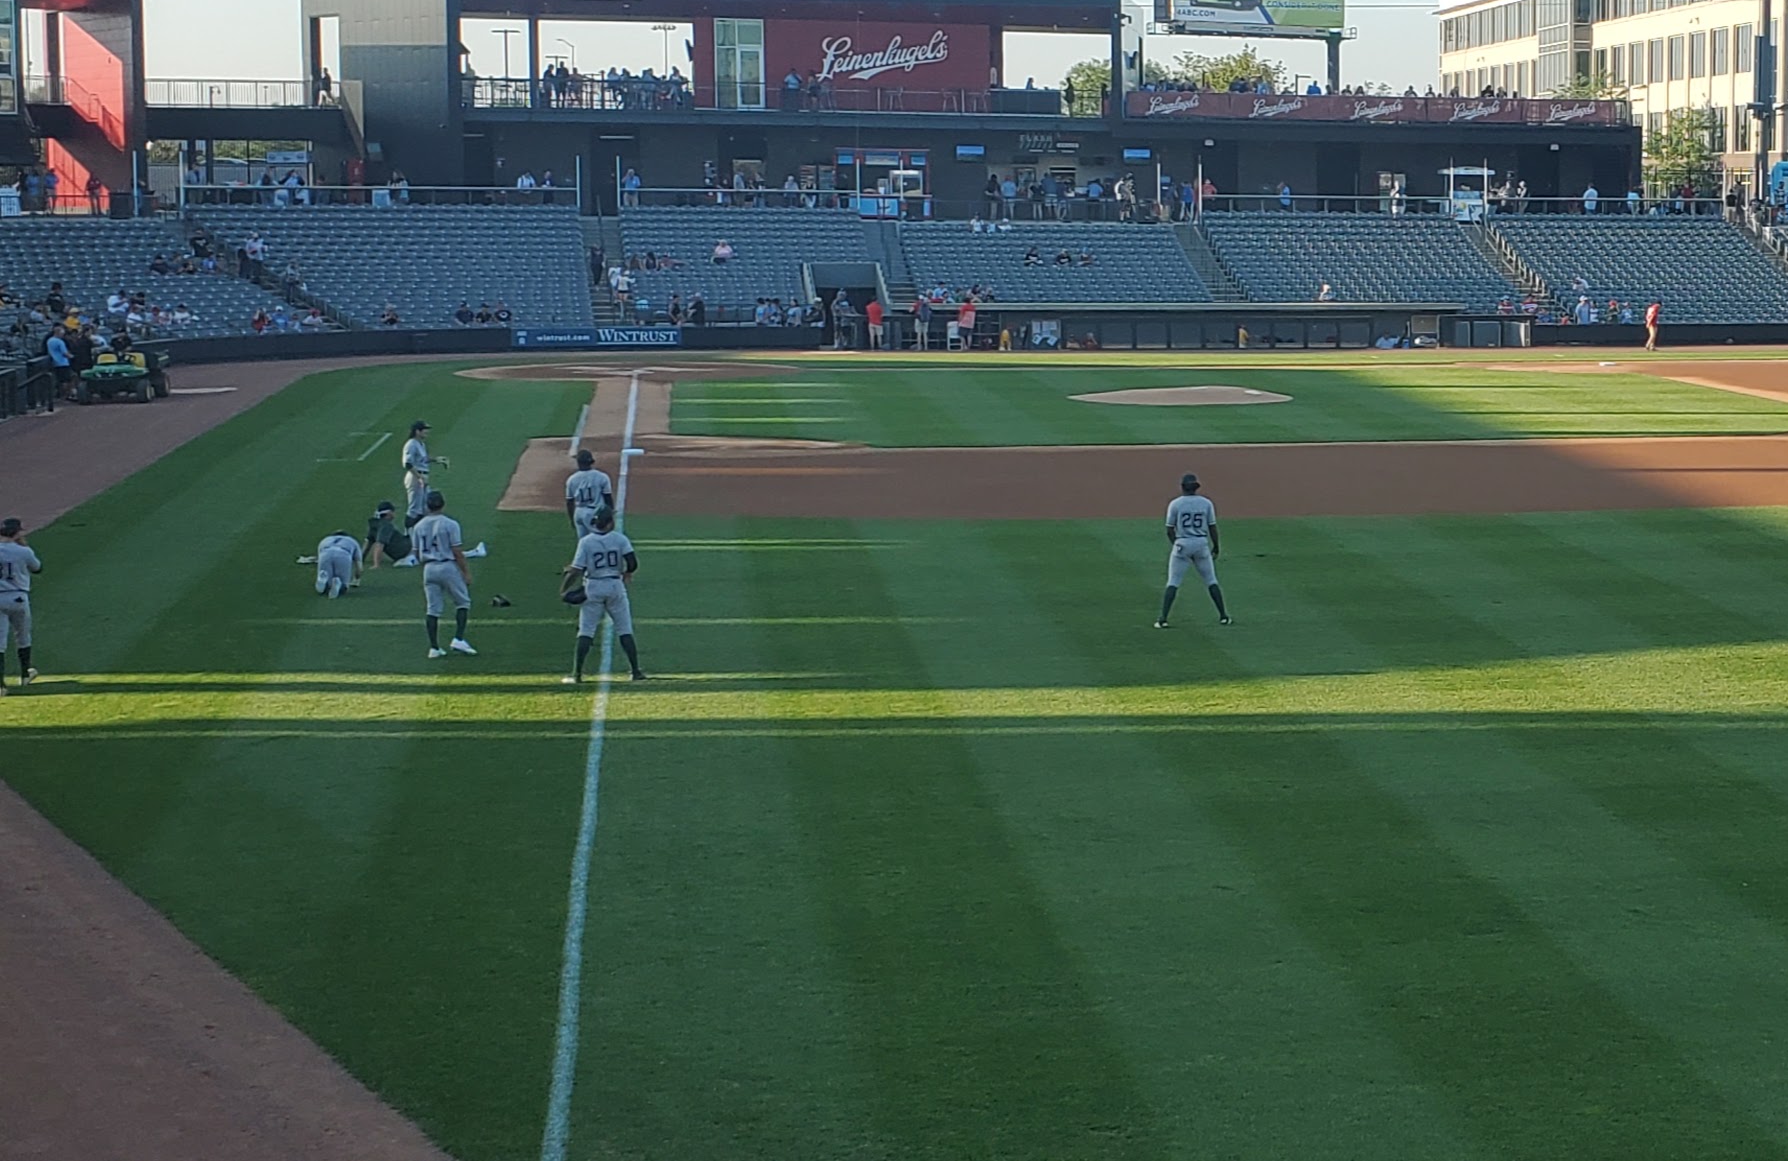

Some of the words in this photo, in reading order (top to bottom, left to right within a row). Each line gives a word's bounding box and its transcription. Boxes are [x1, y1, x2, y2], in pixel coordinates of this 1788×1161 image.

[815, 30, 948, 82] Leinenkugel's
[597, 329, 677, 342] WINTRUST
[579, 487, 593, 503] 11
[1181, 512, 1203, 529] 25
[593, 550, 618, 569] 20
